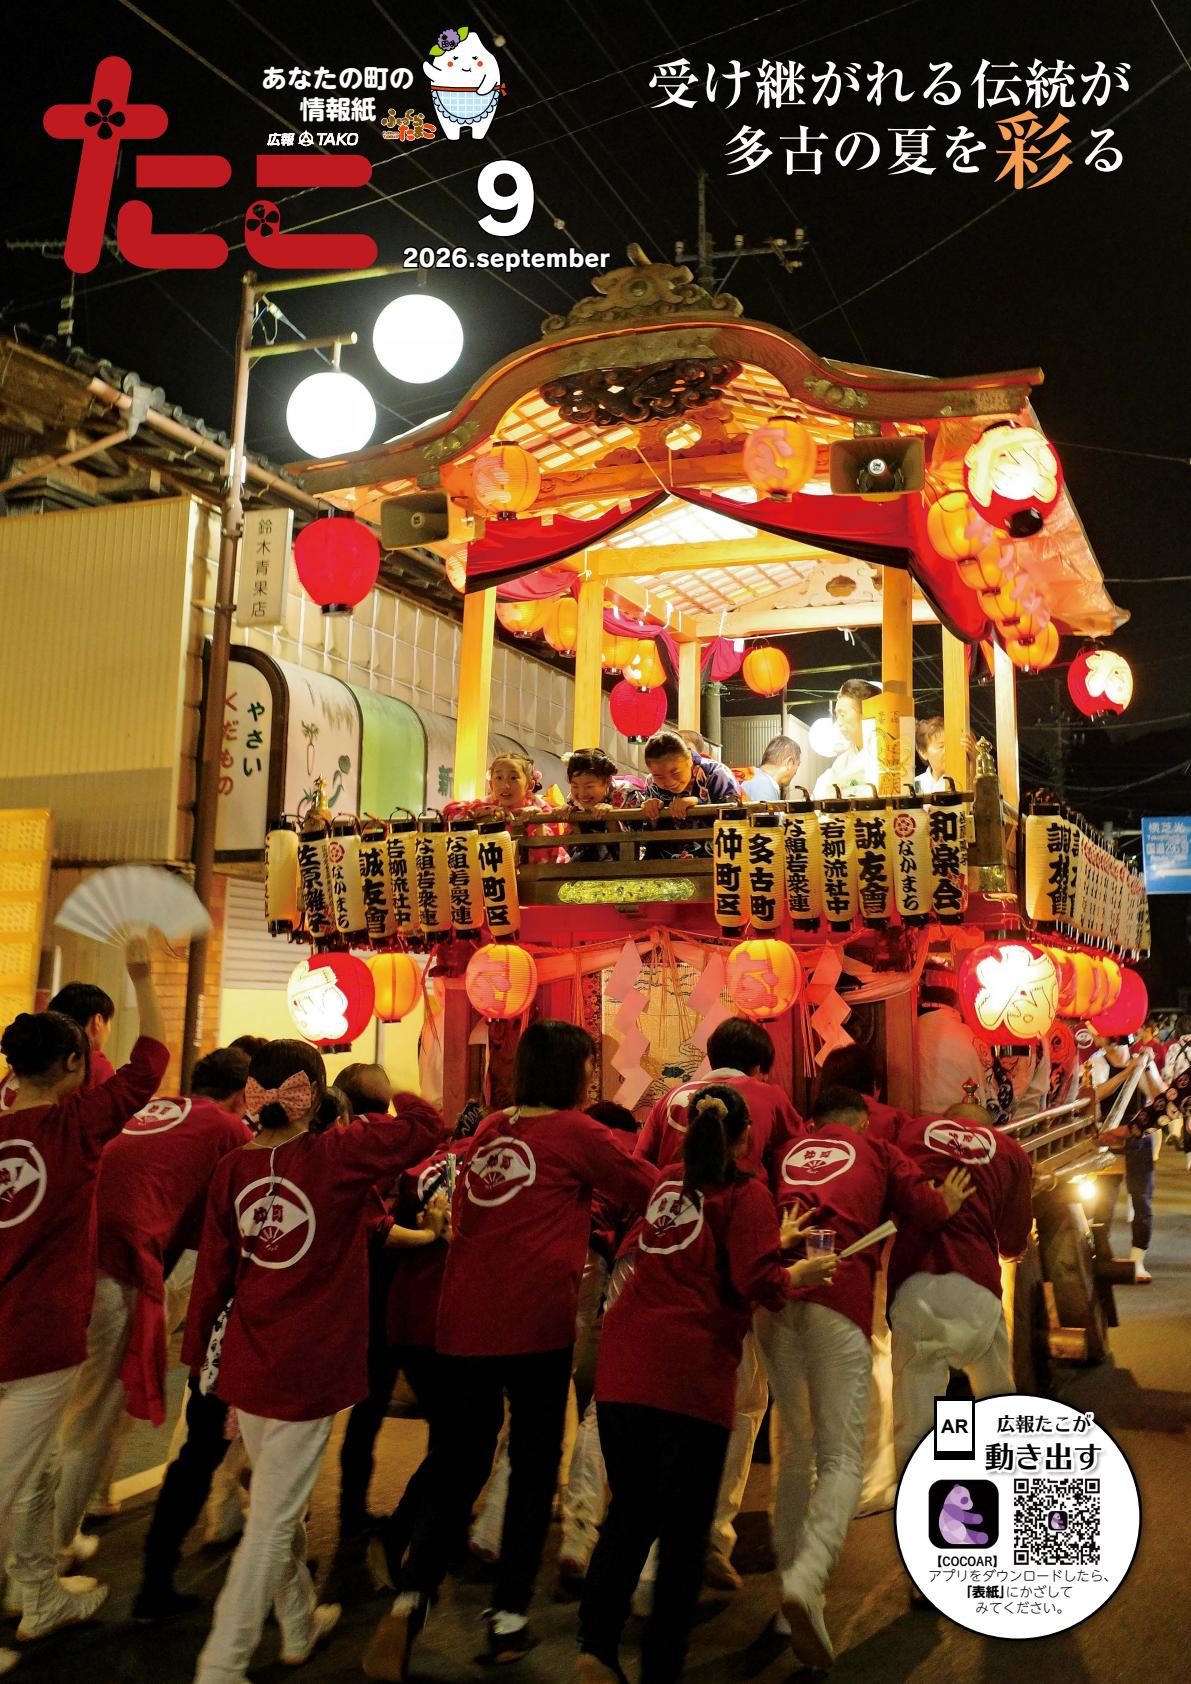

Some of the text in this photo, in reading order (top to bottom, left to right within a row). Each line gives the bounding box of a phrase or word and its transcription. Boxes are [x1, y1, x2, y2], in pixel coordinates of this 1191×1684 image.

[251, 519, 273, 618] 鈴木青果店
[243, 701, 265, 777] やさい
[332, 865, 350, 929] なかまち
[446, 836, 473, 925] な組若衆連
[478, 841, 512, 927] 仲町区
[714, 827, 742, 917] 仲町区
[748, 832, 776, 922] 多古町
[783, 818, 811, 913] な組若衆連
[819, 817, 850, 915] 若柳流社中
[854, 816, 889, 914] 誠友會
[898, 839, 920, 912] なかまち
